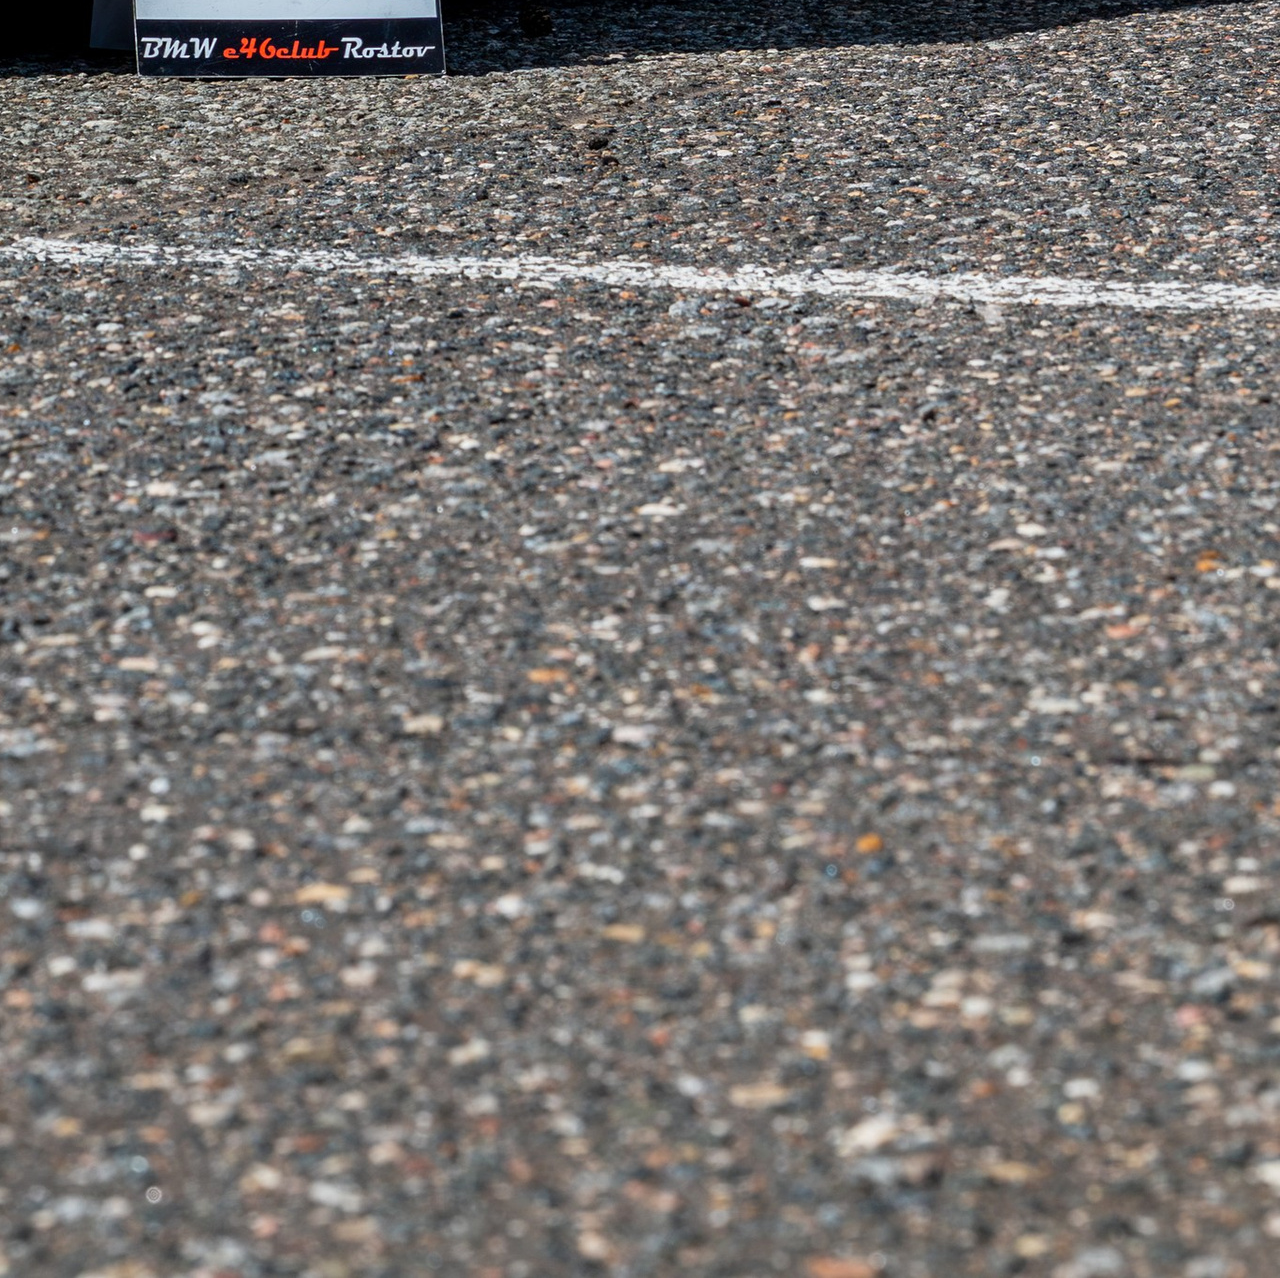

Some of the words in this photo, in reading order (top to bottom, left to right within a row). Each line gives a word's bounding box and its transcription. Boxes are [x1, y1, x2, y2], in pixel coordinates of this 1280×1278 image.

[140, 37, 218, 59] BMW
[222, 37, 339, 59] e46club
[340, 37, 435, 58] Rostov
